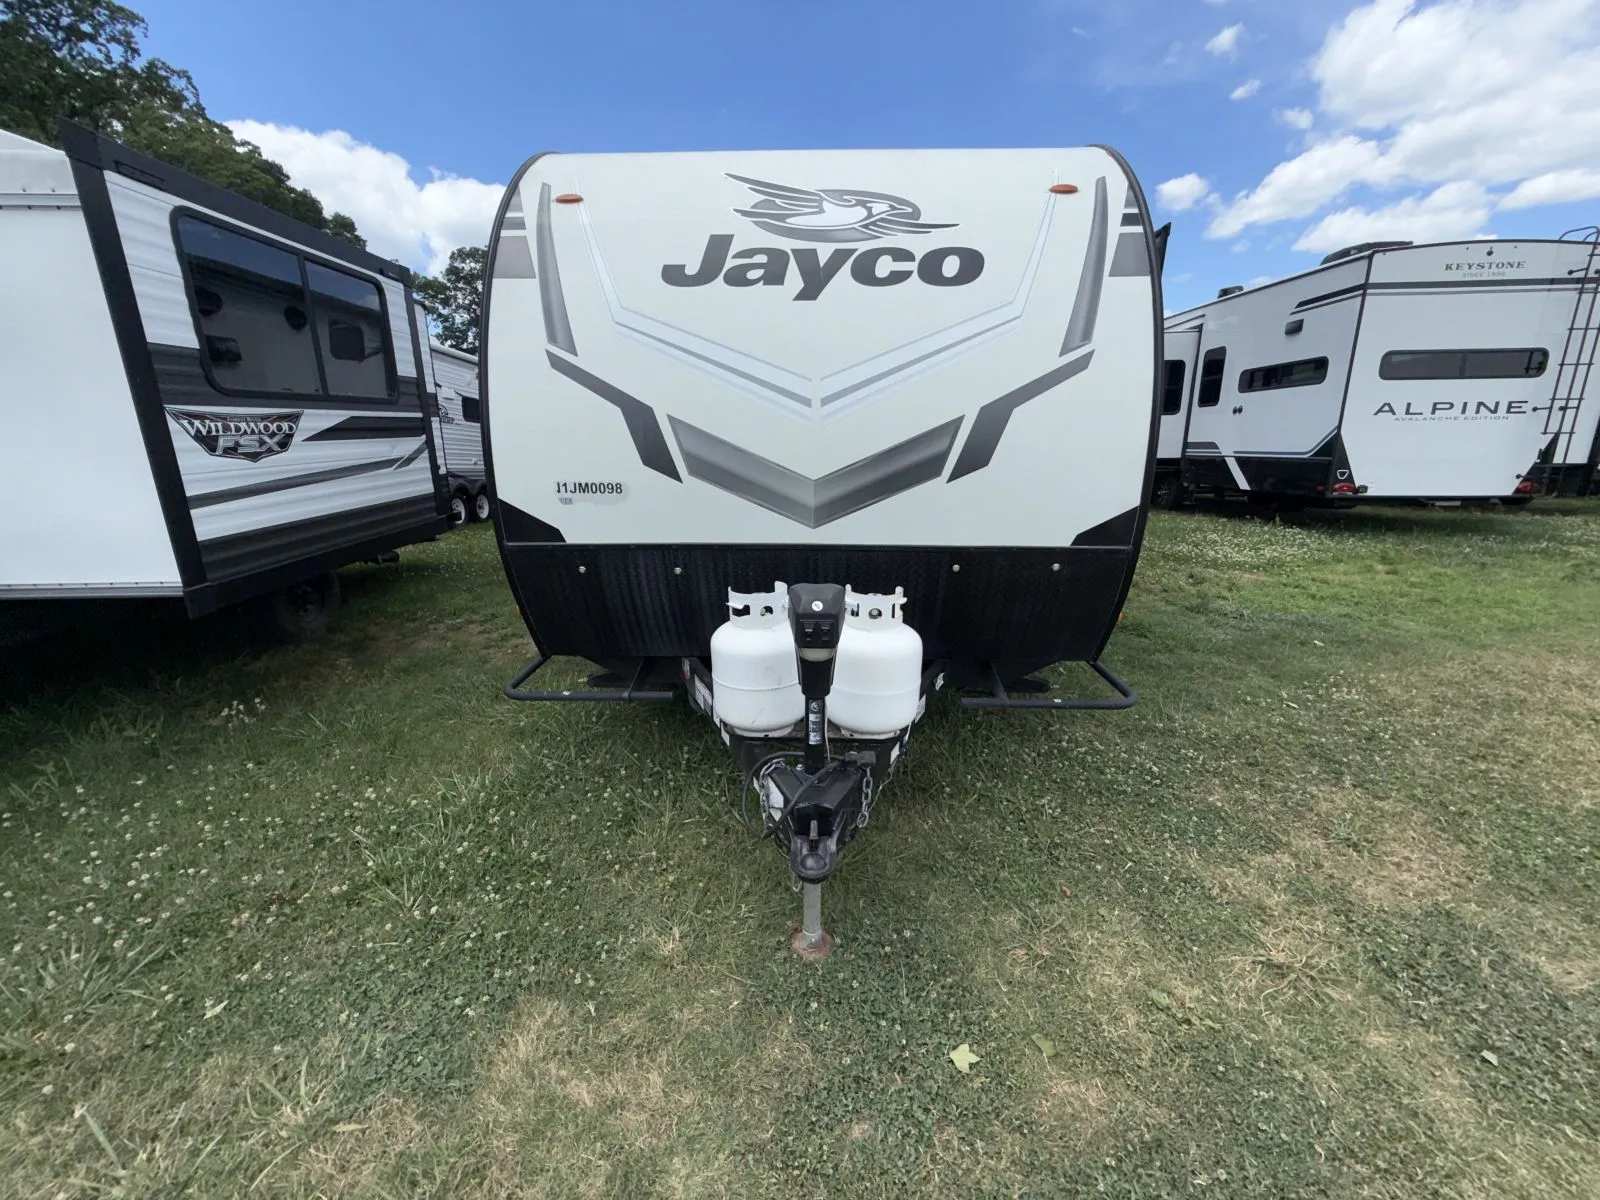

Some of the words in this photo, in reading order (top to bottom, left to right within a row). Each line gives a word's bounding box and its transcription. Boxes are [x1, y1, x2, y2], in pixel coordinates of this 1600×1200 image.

[661, 233, 985, 301] Jayco
[1445, 260, 1527, 271] KEYSTONE
[1373, 400, 1529, 416] ALPINE
[179, 419, 297, 437] WILDWOOD
[215, 434, 286, 455] FSX
